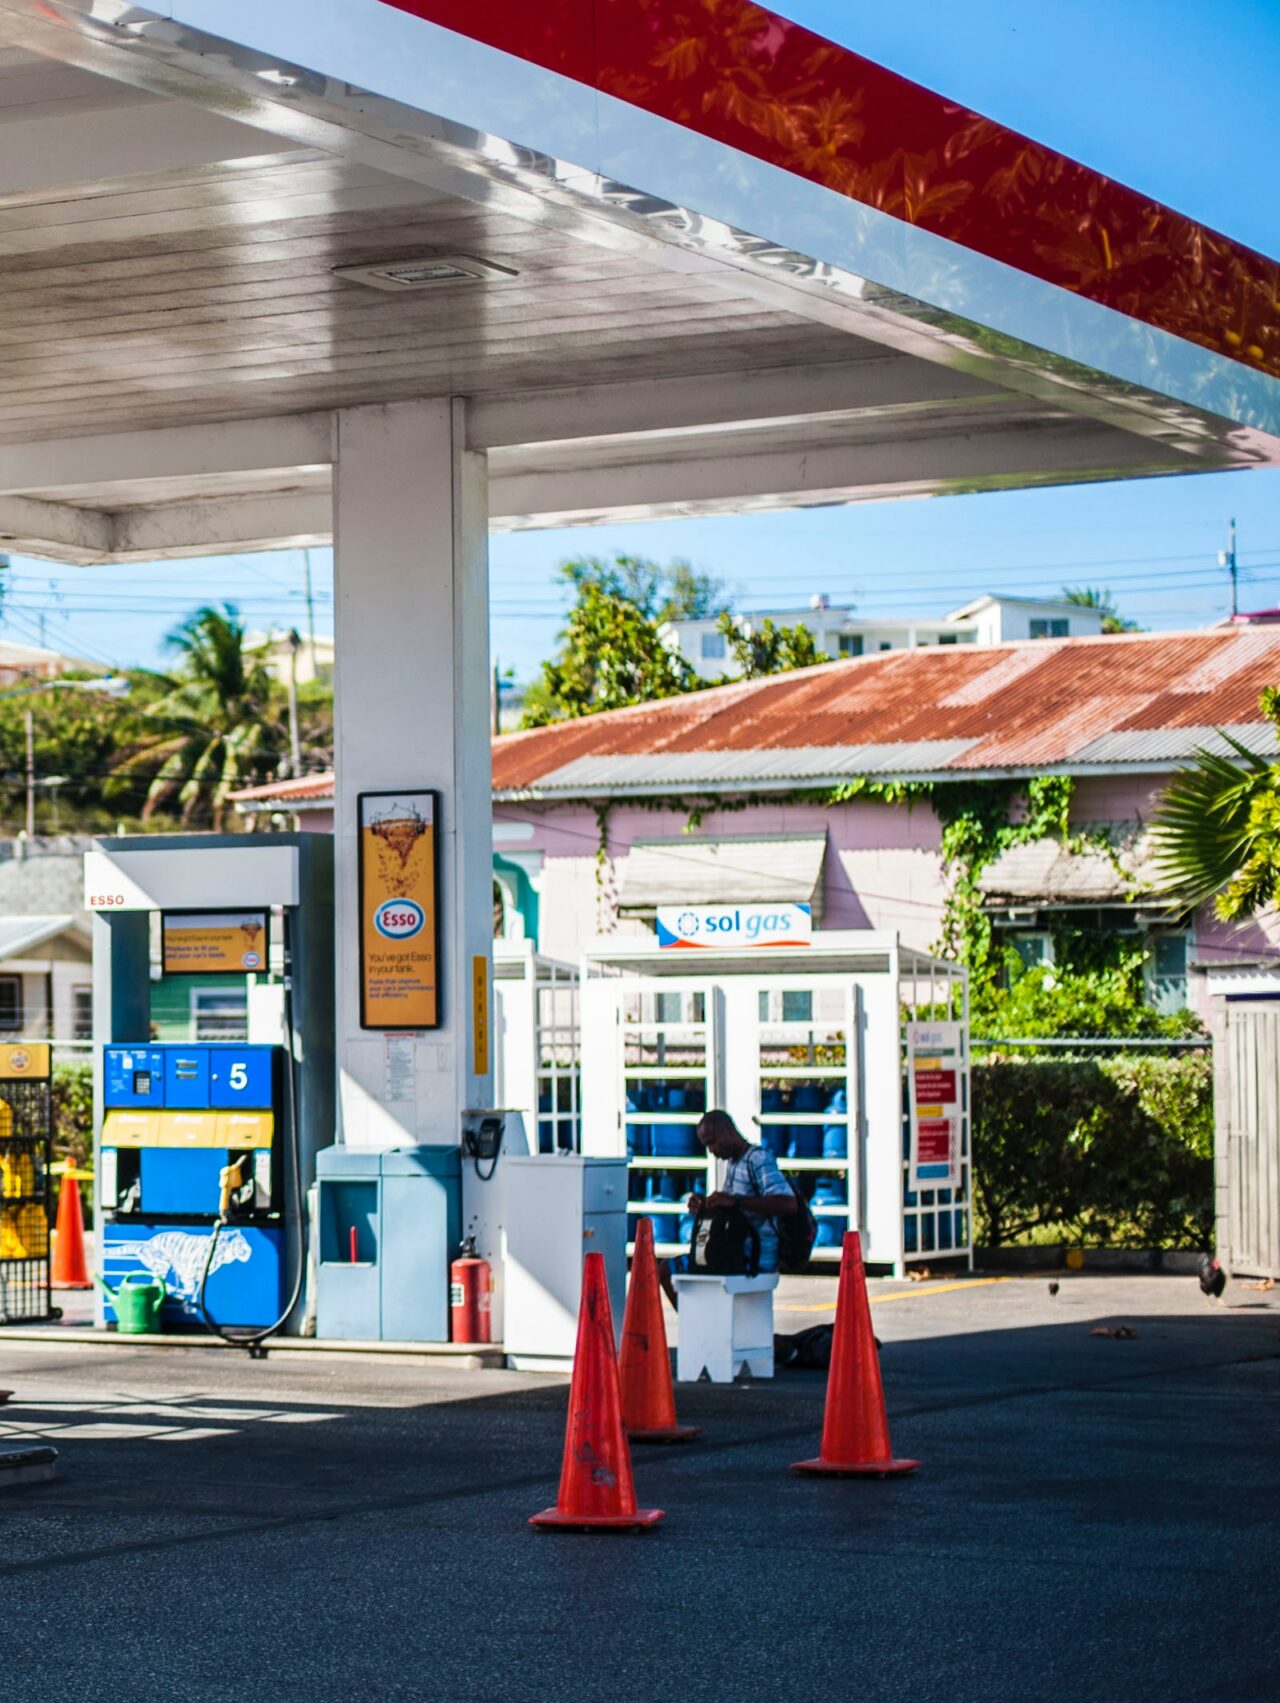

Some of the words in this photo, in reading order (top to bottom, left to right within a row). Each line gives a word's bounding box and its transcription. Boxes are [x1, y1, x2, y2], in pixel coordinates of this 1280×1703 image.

[90, 895, 125, 906] ESSO
[382, 911, 416, 927] Esso
[705, 910, 740, 932] sol
[745, 912, 792, 939] gas
[411, 952, 432, 962] Esso
[228, 1062, 248, 1091] 5
